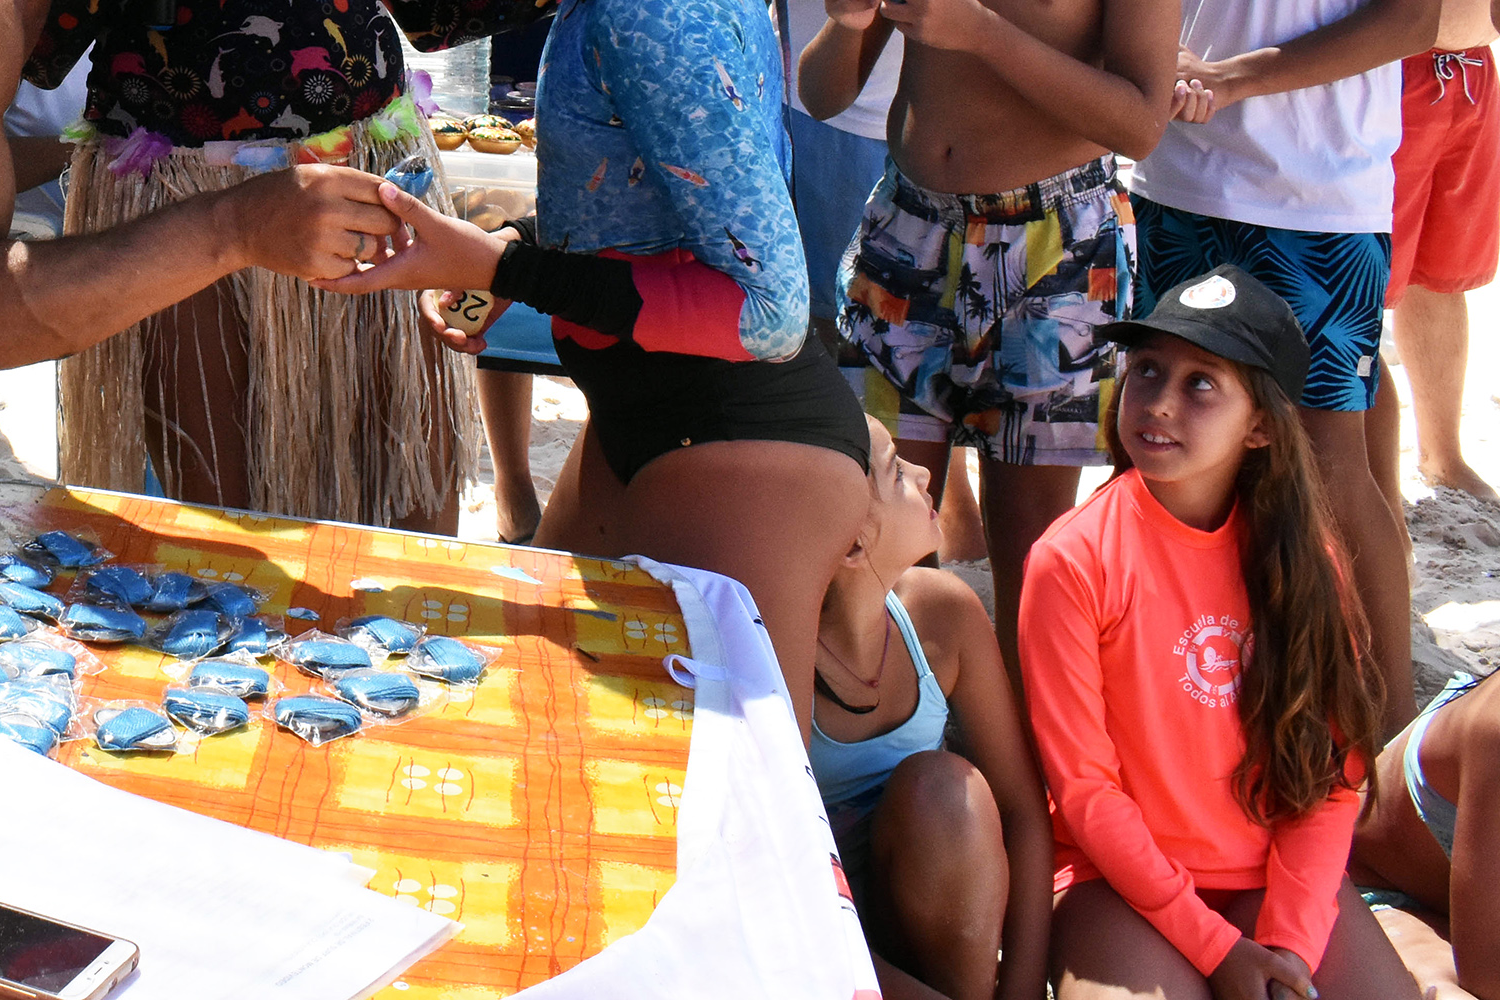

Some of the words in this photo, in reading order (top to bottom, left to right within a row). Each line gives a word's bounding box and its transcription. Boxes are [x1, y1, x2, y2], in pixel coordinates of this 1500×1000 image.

[1173, 614, 1216, 656] Escuela
[1220, 614, 1239, 629] de
[1178, 672, 1217, 708] Todos
[1220, 695, 1229, 708] al
